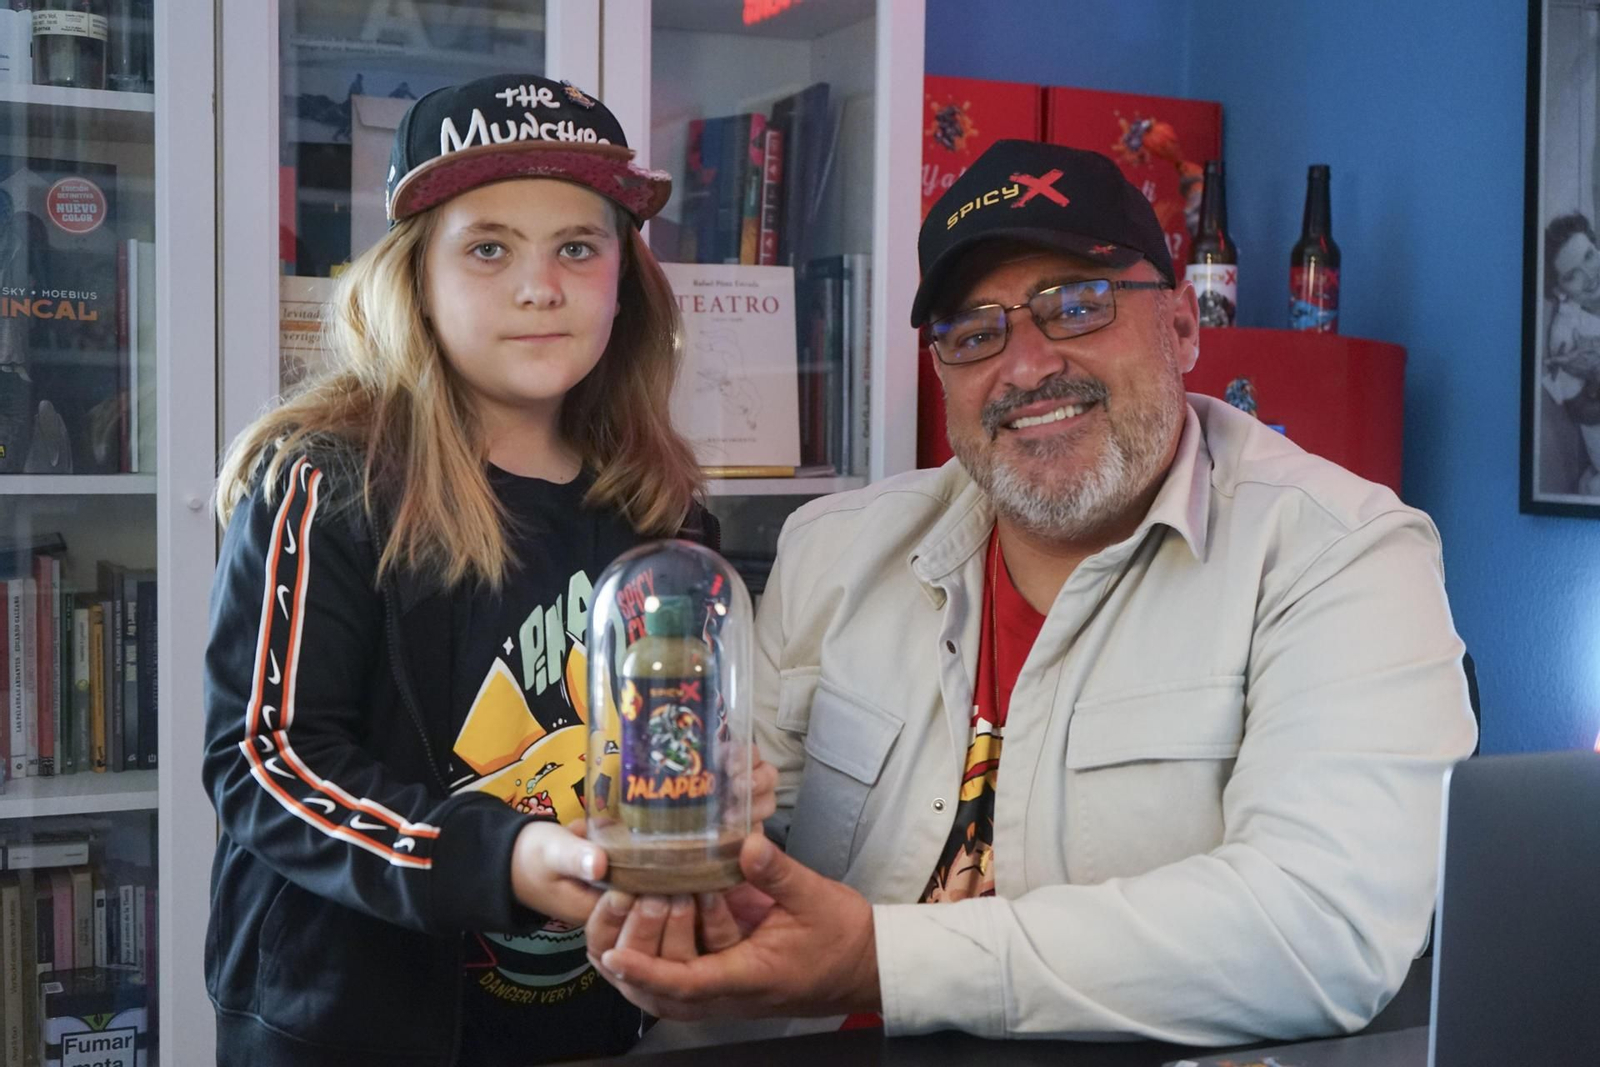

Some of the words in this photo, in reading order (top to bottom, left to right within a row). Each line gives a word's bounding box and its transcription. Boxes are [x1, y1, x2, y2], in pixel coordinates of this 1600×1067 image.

[56, 203, 98, 214] NUEVO
[62, 213, 94, 222] COLOR
[41, 289, 98, 300] MOEBIUS
[674, 294, 780, 315] TEATRO
[0, 297, 98, 321] INCAL
[479, 971, 537, 1004] DANGER!
[541, 984, 577, 1004] VERY
[64, 1035, 133, 1055] Fumar
